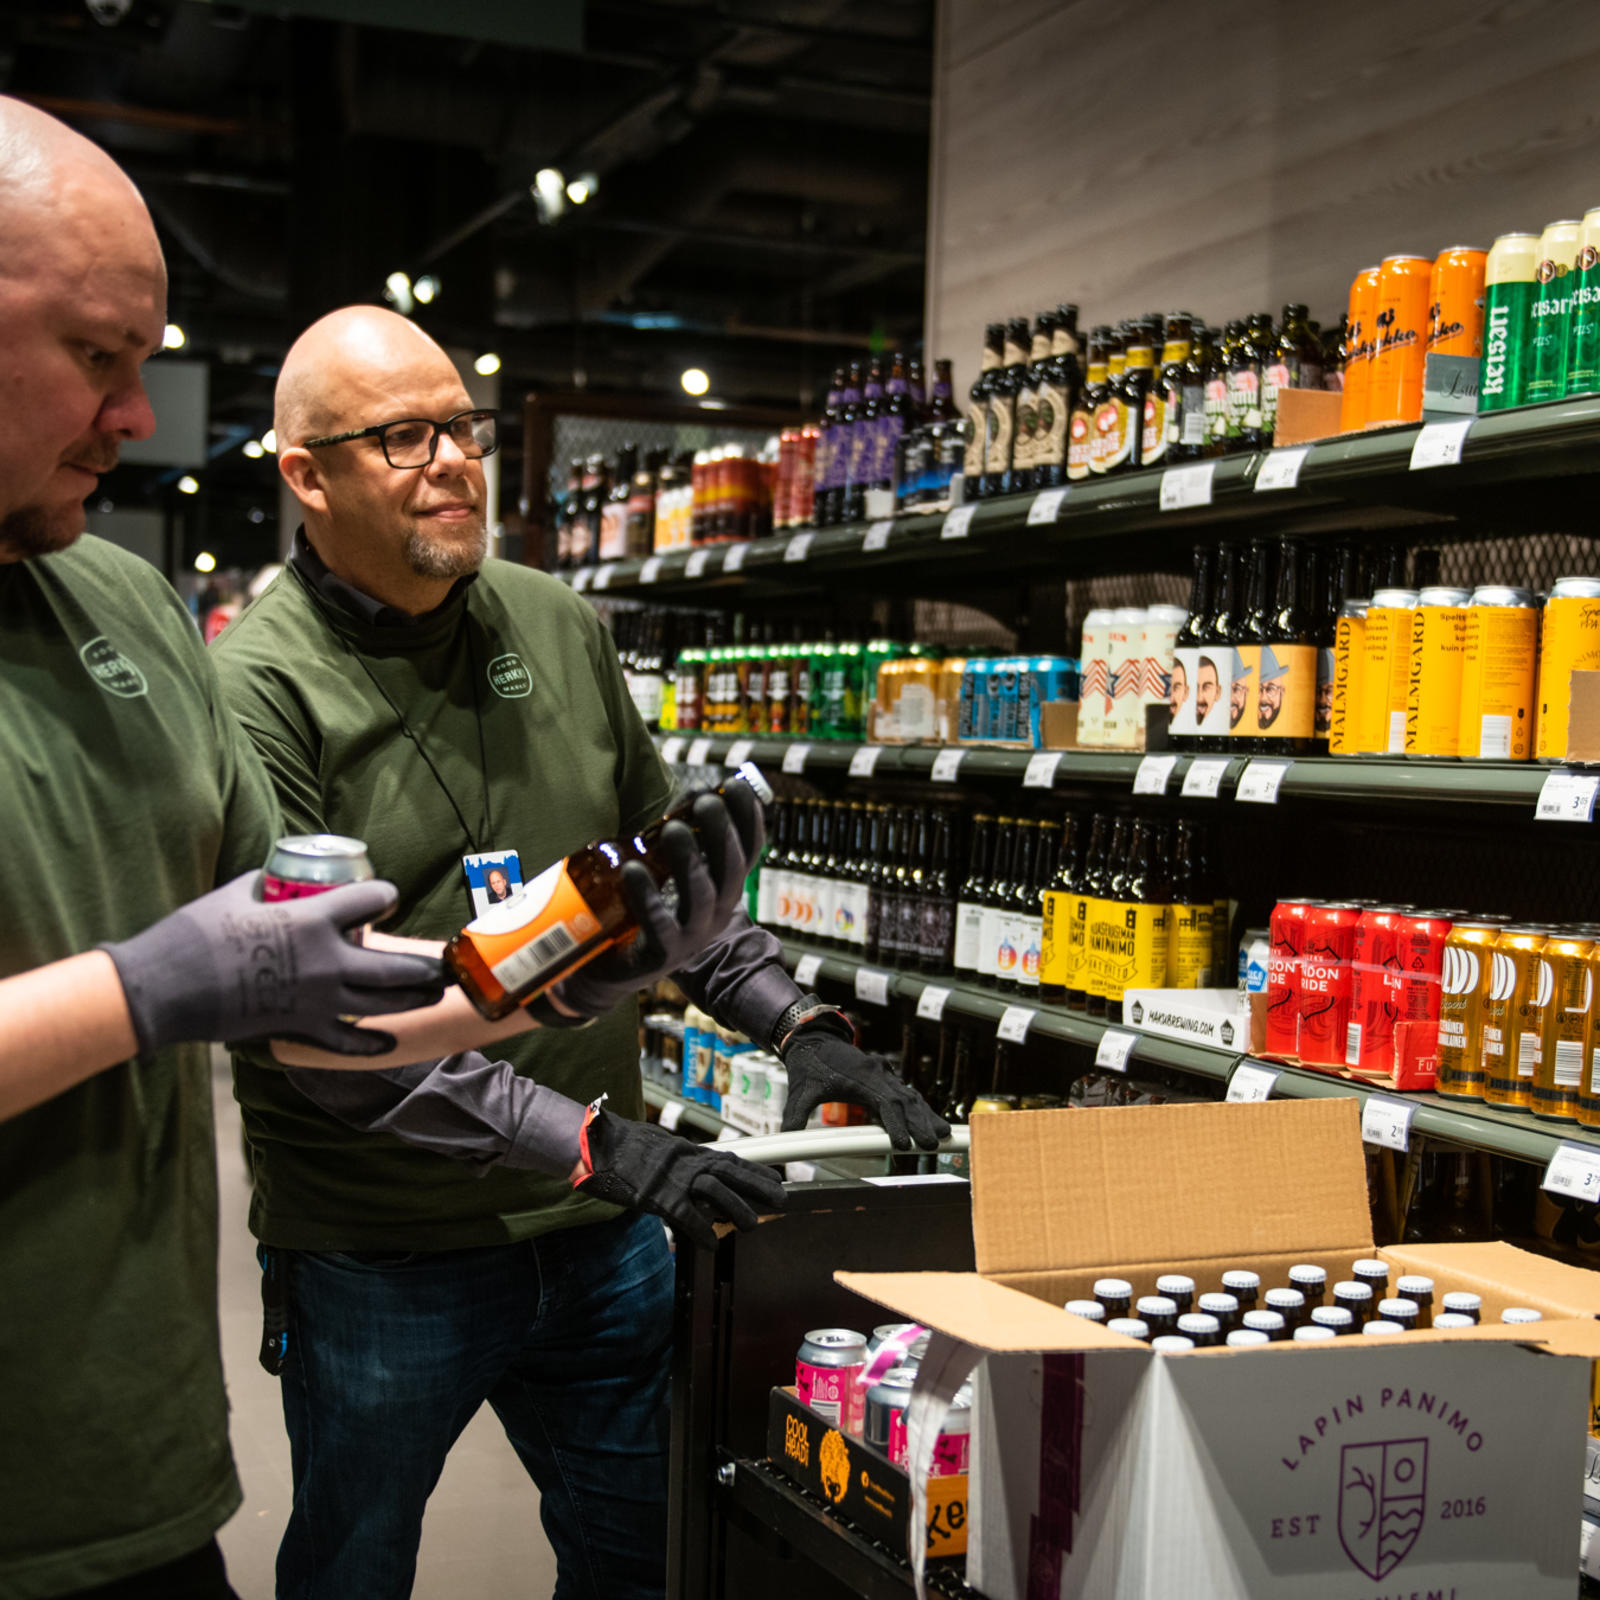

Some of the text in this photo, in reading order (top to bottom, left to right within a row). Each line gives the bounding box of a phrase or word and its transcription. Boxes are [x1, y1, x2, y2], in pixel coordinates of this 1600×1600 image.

[1332, 622, 1350, 749] MALMGARD
[1406, 612, 1426, 749] MALMGARD
[1282, 1388, 1484, 1471] LAPIN PANIMO
[1271, 1514, 1321, 1539] EST
[1441, 1497, 1486, 1519] 2016
